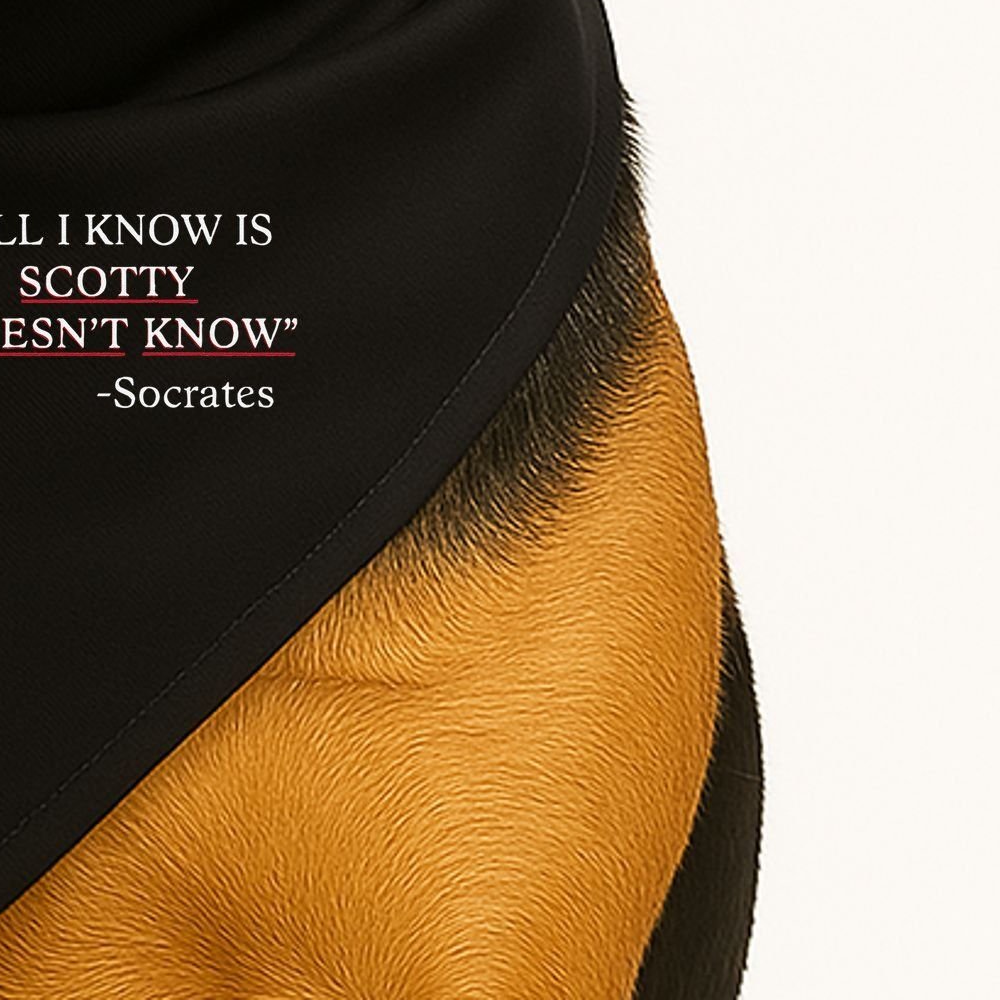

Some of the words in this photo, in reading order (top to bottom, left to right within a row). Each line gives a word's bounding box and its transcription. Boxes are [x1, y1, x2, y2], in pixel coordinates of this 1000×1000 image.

[57, 214, 70, 246] I
[84, 213, 223, 247] KNOW
[235, 213, 273, 247] IS
[18, 264, 196, 299] SCOTTY
[143, 316, 299, 350] KNOW”
[96, 375, 275, 409] -Socrates
